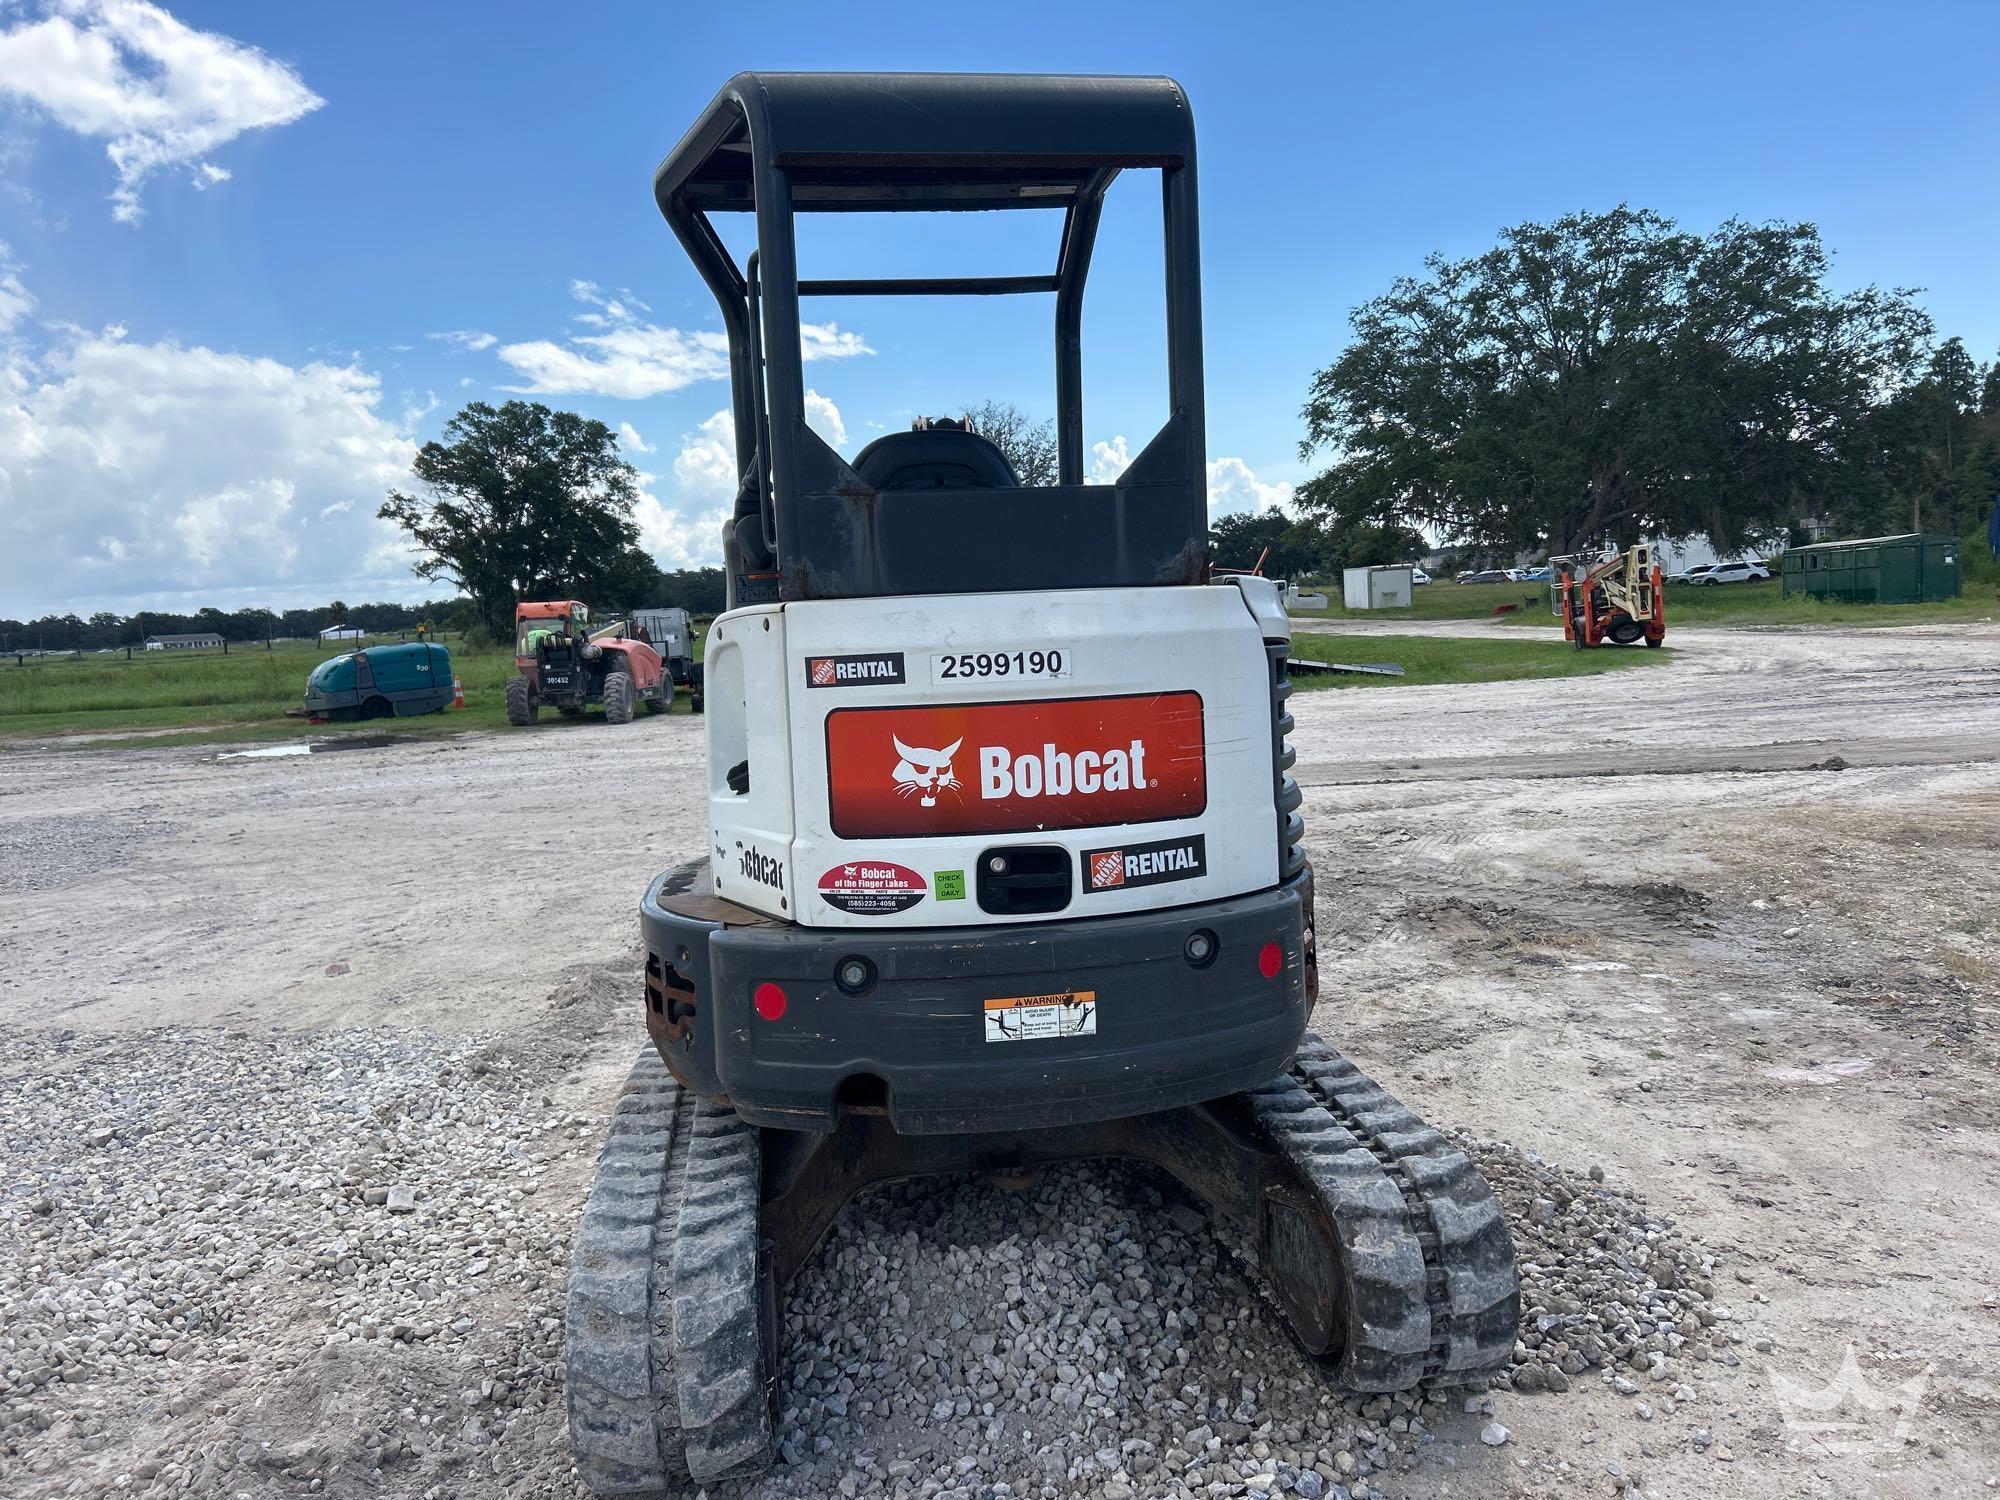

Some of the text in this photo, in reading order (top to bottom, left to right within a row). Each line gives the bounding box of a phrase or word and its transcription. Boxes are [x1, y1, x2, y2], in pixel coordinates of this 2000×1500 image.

[813, 659, 835, 684] HOME
[836, 661, 897, 679] RENTAL
[940, 650, 1062, 678] 2599190
[980, 740, 1146, 799] Bobcat
[1093, 851, 1122, 887] HOME
[1125, 847, 1199, 877] RENTAL
[858, 880, 884, 888] Finger
[885, 880, 909, 888] Lakes
[861, 868, 896, 879] Bobcat
[937, 874, 961, 882] CHECK
[941, 889, 960, 897] DAILY
